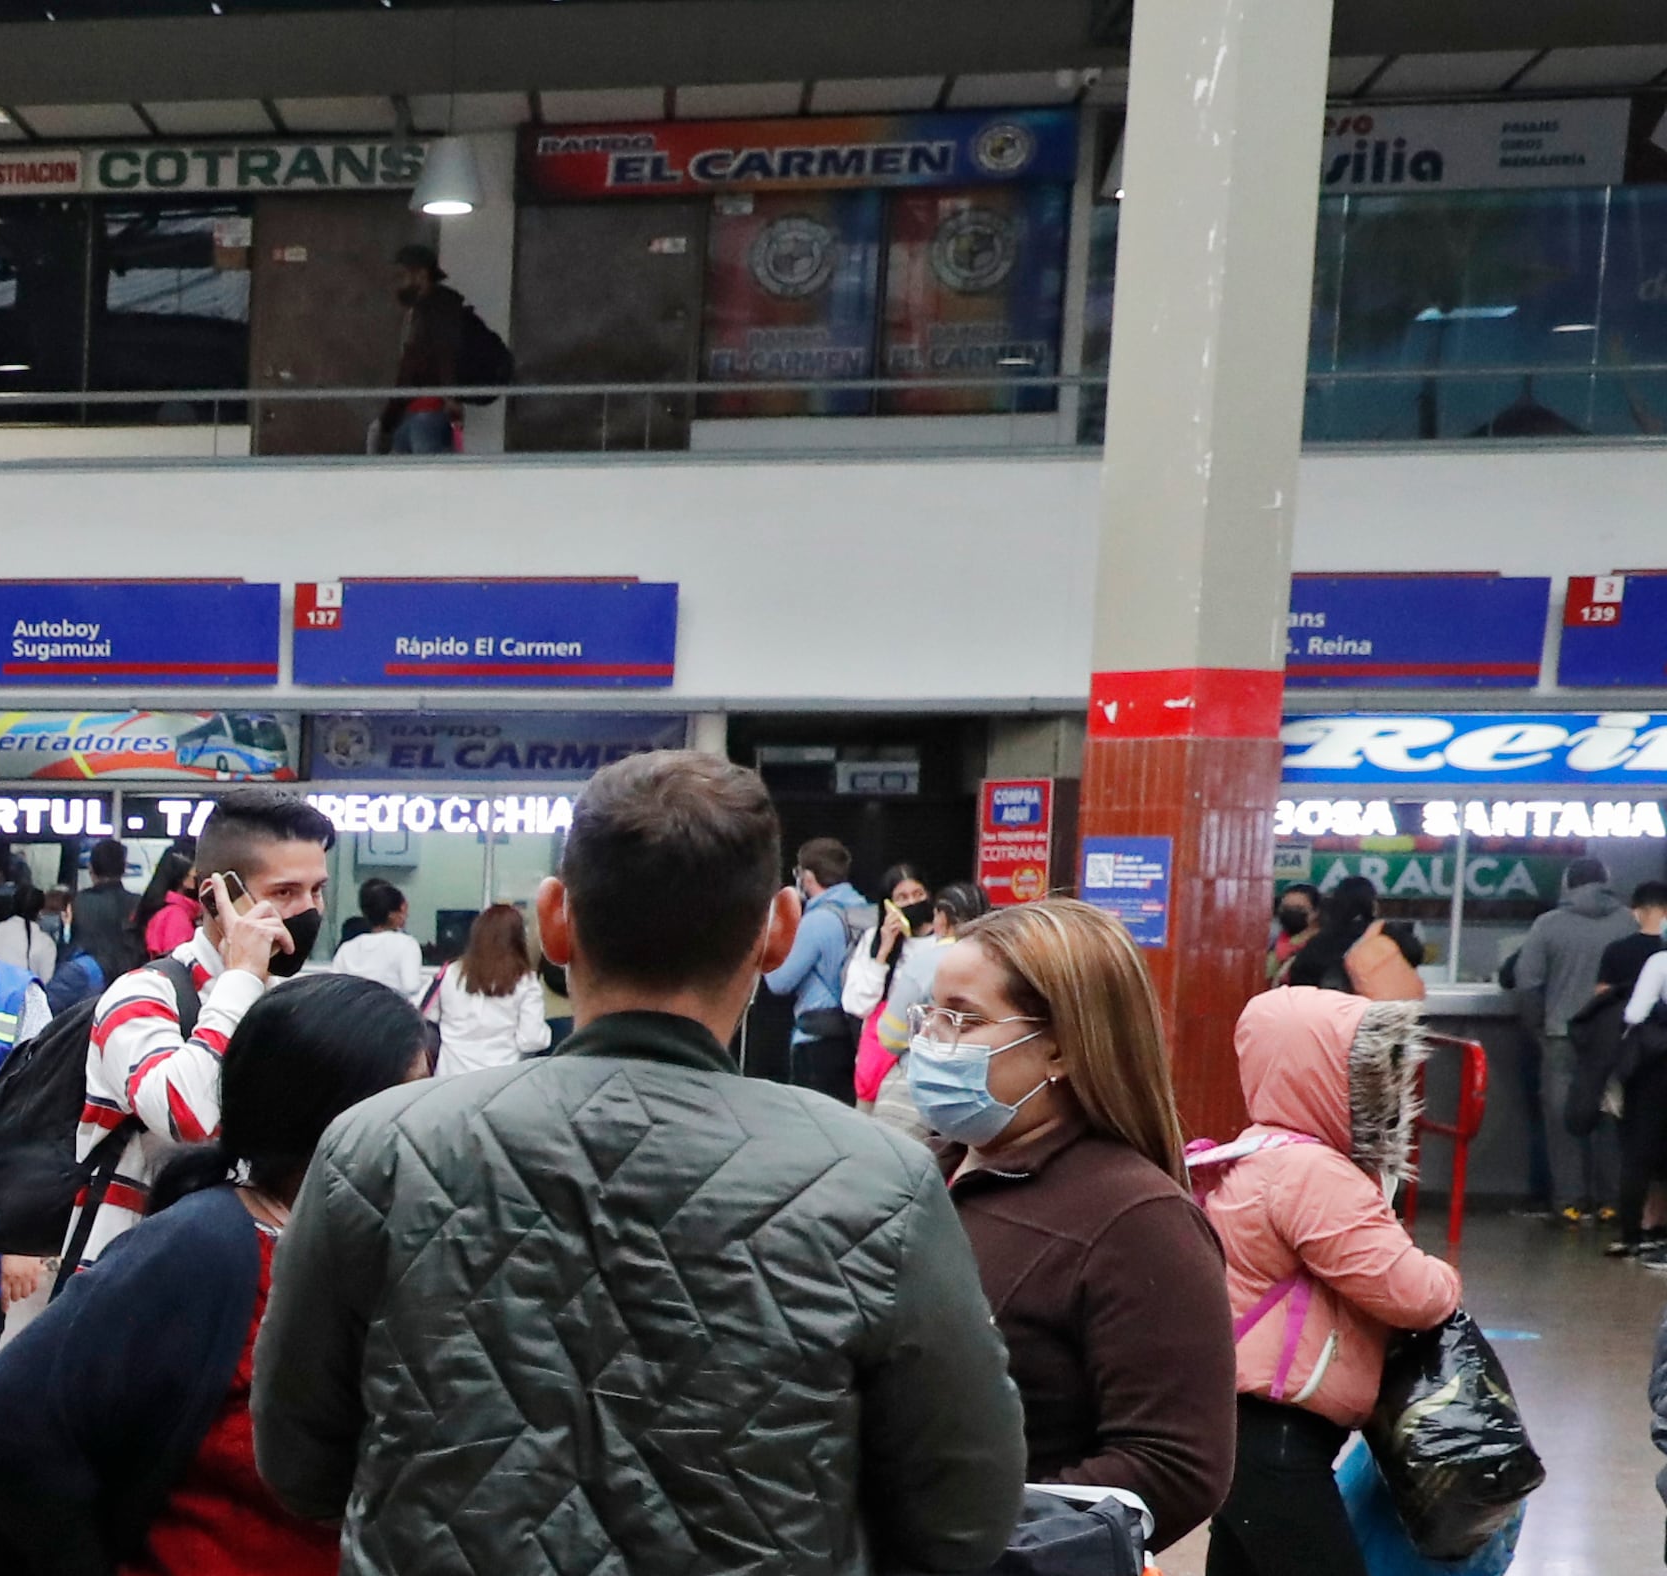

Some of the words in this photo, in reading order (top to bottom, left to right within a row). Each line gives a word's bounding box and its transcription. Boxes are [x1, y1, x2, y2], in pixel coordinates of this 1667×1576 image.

[538, 134, 655, 154] RAPIDO
[97, 144, 428, 188] COTRANS
[606, 153, 683, 187] EL
[689, 141, 956, 182] CARMEN
[1323, 137, 1444, 185] silia
[1604, 583, 1615, 596] 3
[307, 611, 337, 625] 137
[1288, 612, 1326, 628] ans
[1581, 607, 1616, 622] 139
[13, 619, 101, 641] Autoboy
[12, 640, 111, 661] Sugamuxi
[395, 636, 468, 659] Rápido
[475, 637, 495, 656] El
[500, 637, 582, 657] Carmen
[1307, 637, 1372, 656] Reina
[389, 724, 502, 738] RAPIDO
[388, 743, 446, 770] EL
[994, 788, 1040, 805] COMPRA
[1421, 799, 1666, 837] SANTANA
[982, 845, 1046, 862] COTRANS
[1319, 856, 1539, 896] ARAUCA
